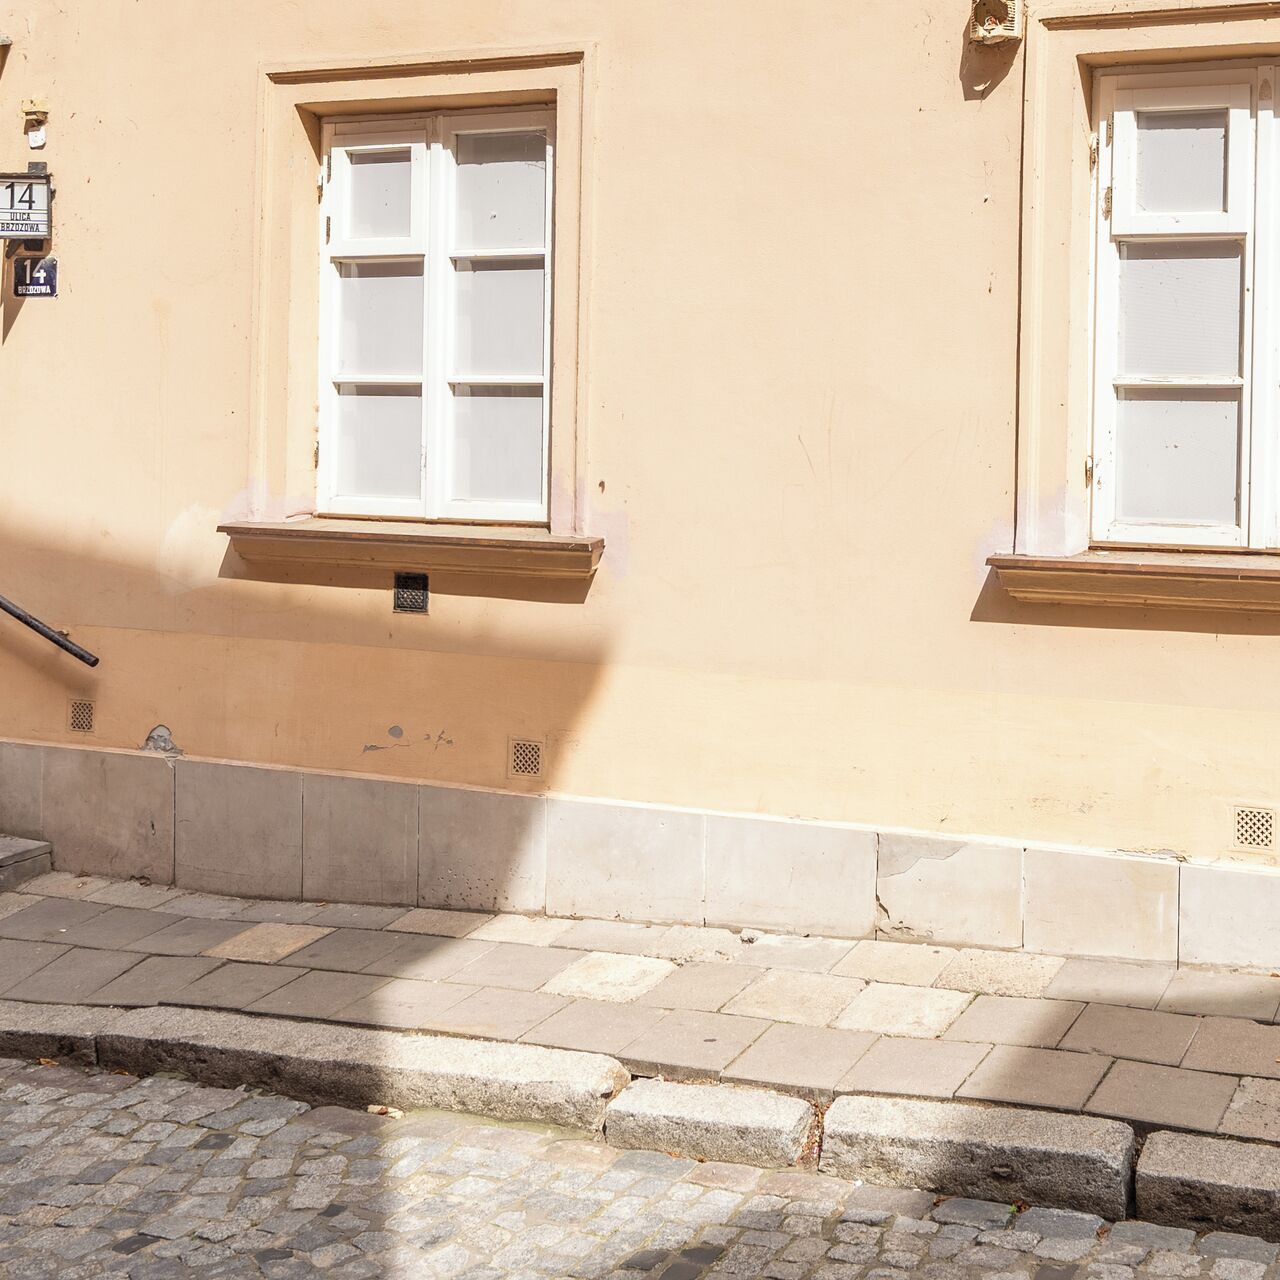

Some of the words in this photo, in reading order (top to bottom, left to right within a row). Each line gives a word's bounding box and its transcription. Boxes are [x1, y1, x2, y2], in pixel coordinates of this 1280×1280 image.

[5, 182, 35, 210] 14
[10, 212, 31, 221] ULICA
[1, 223, 40, 232] BRZOZOWA
[24, 259, 47, 284] 14
[18, 285, 51, 294] BRZOZOWA
